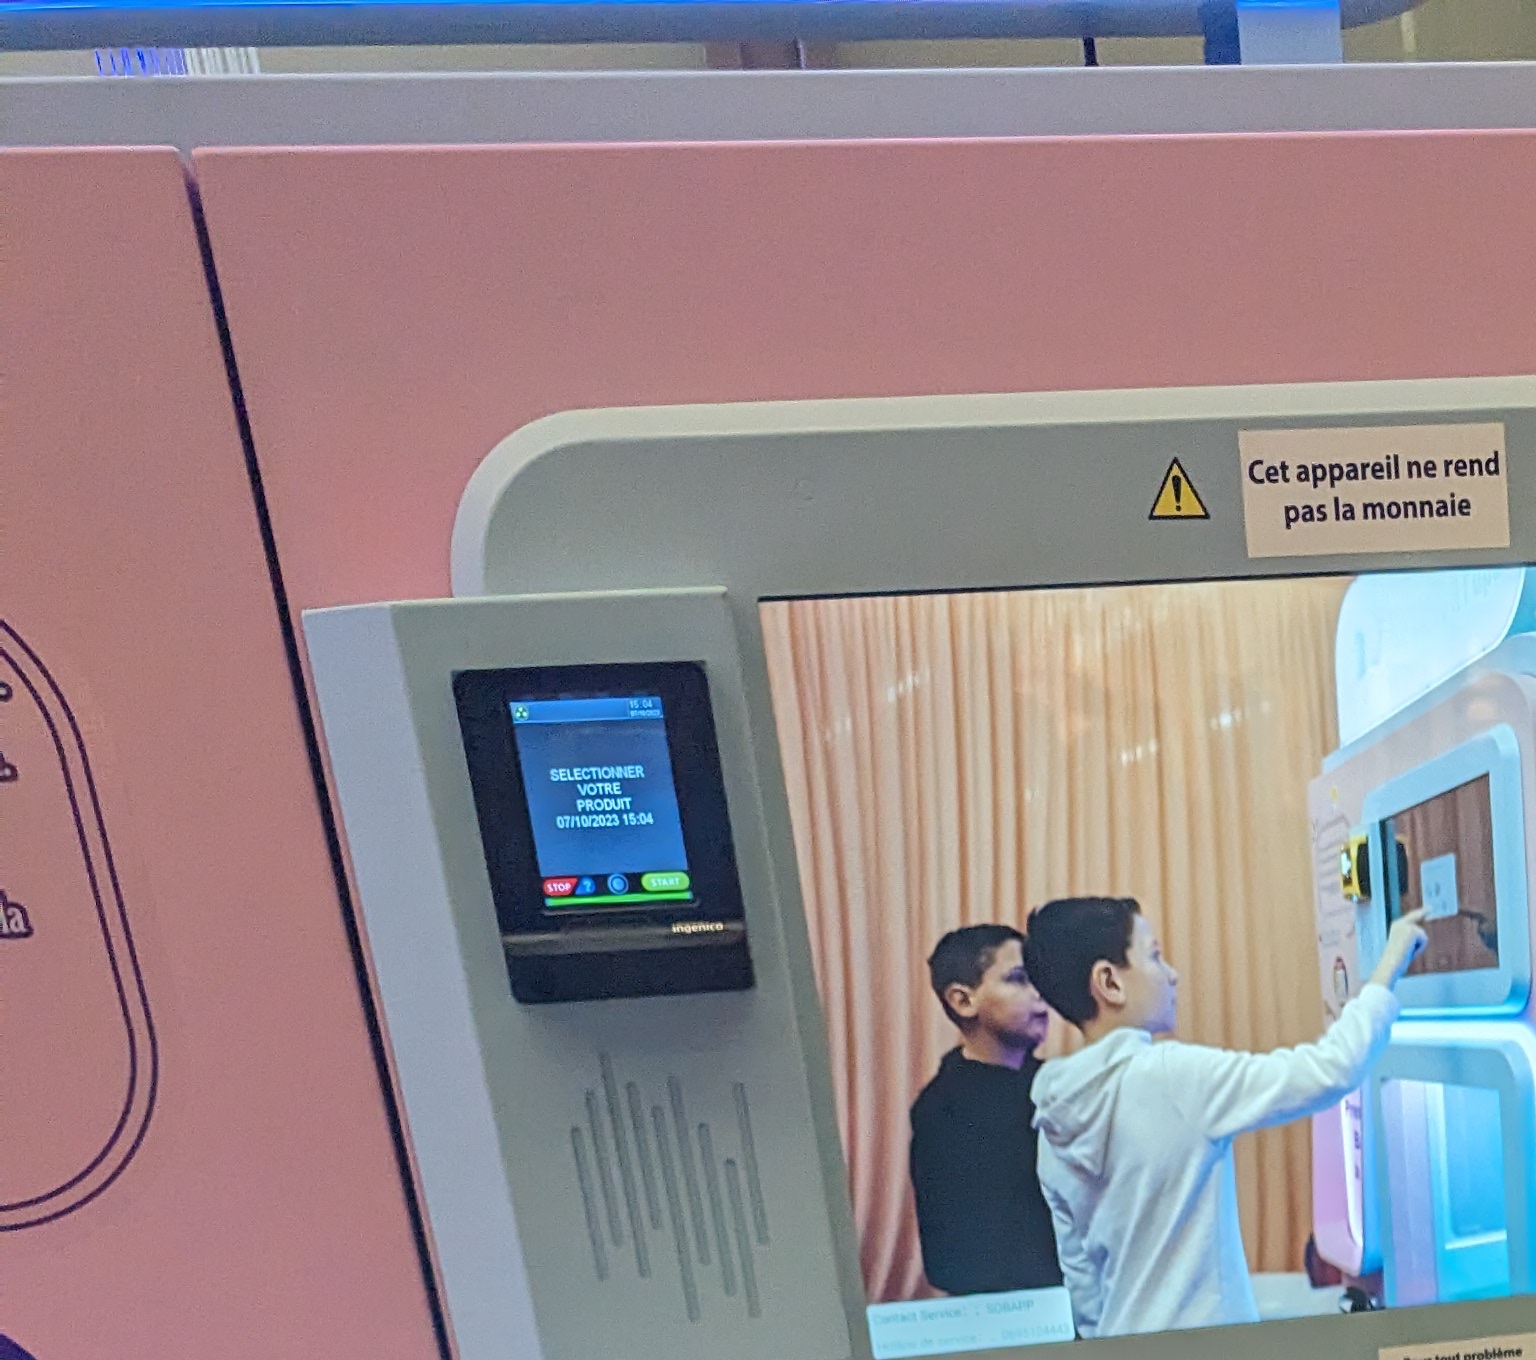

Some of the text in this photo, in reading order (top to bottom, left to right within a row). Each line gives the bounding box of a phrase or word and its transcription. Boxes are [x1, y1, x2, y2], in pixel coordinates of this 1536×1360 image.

[1248, 451, 1500, 489] Cet appareil ne rend
[1284, 492, 1472, 530] pas la monnaie
[549, 764, 645, 781] SELECTIONNER
[576, 782, 623, 796] VOTRE
[576, 797, 632, 812] PRODUIT
[555, 812, 654, 829] 07/10/2023 15:04
[546, 882, 572, 893] STOP
[650, 877, 681, 888] START
[671, 922, 724, 935] ingenico
